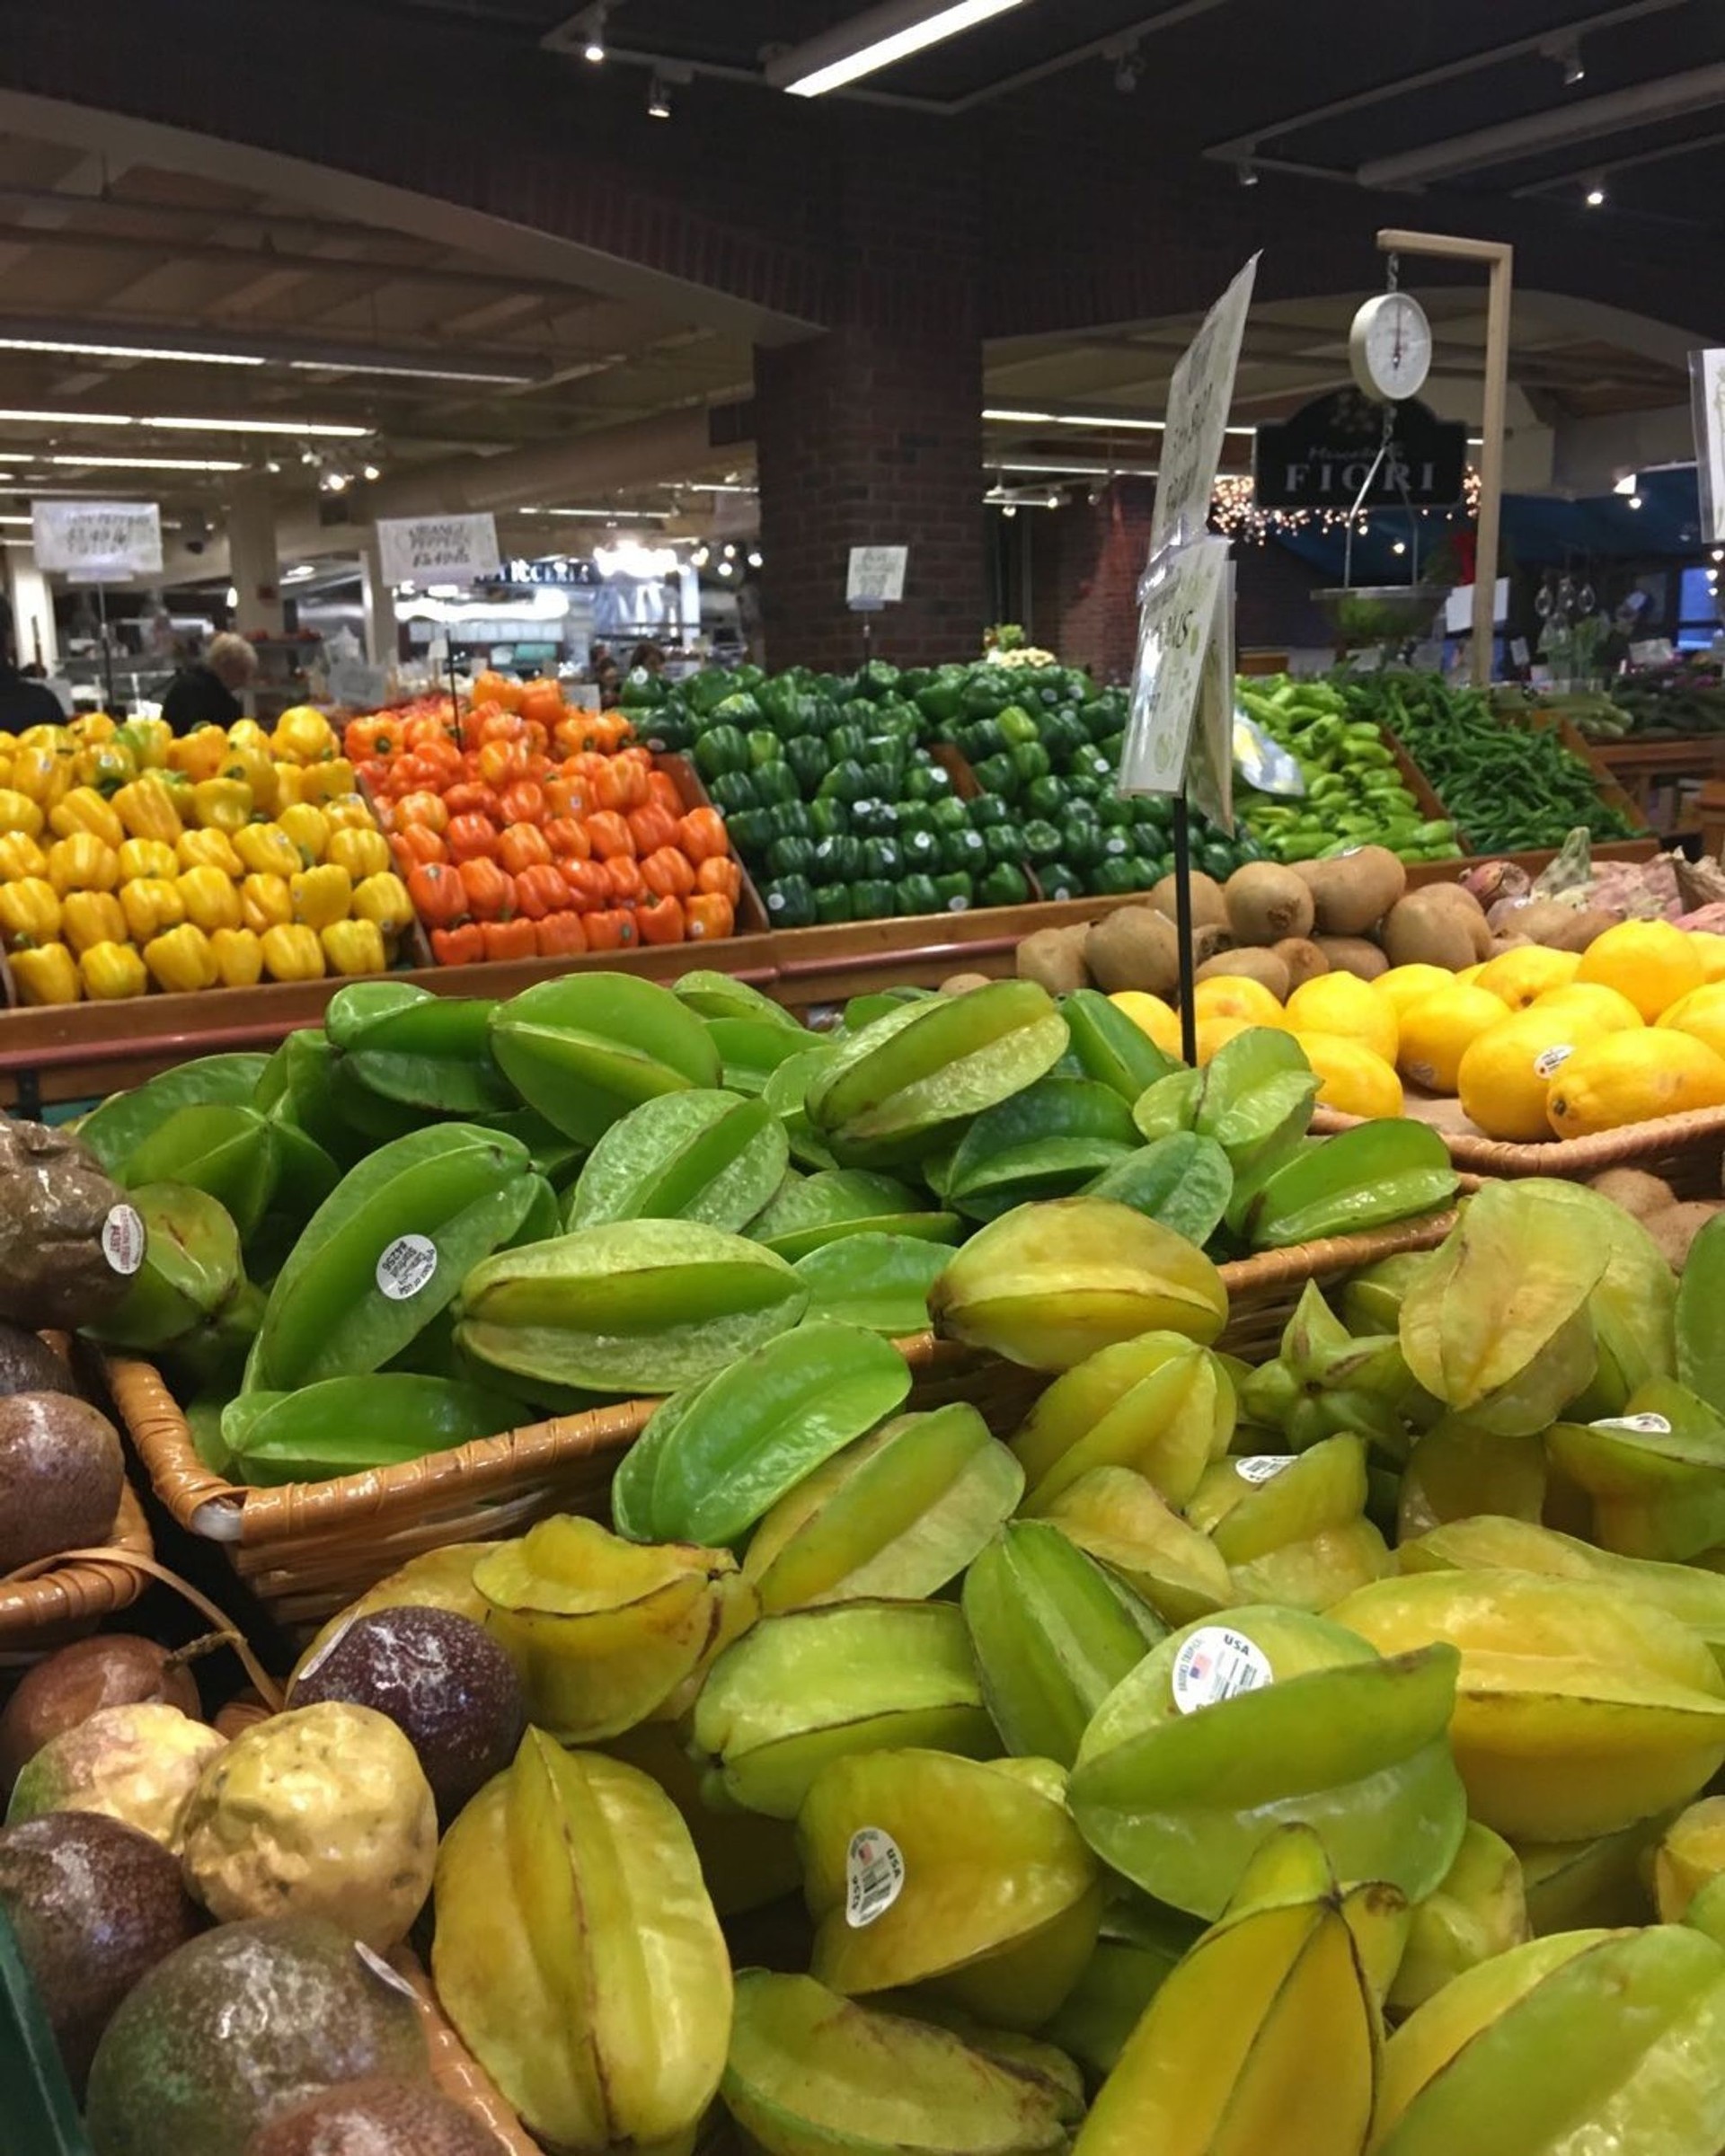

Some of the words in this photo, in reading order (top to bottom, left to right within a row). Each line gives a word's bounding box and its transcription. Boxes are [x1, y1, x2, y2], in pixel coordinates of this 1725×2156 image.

[1285, 462, 1436, 491] FIORI
[380, 1241, 408, 1272] #4256
[1224, 1633, 1250, 1656] USA
[886, 1848, 901, 1879] USA
